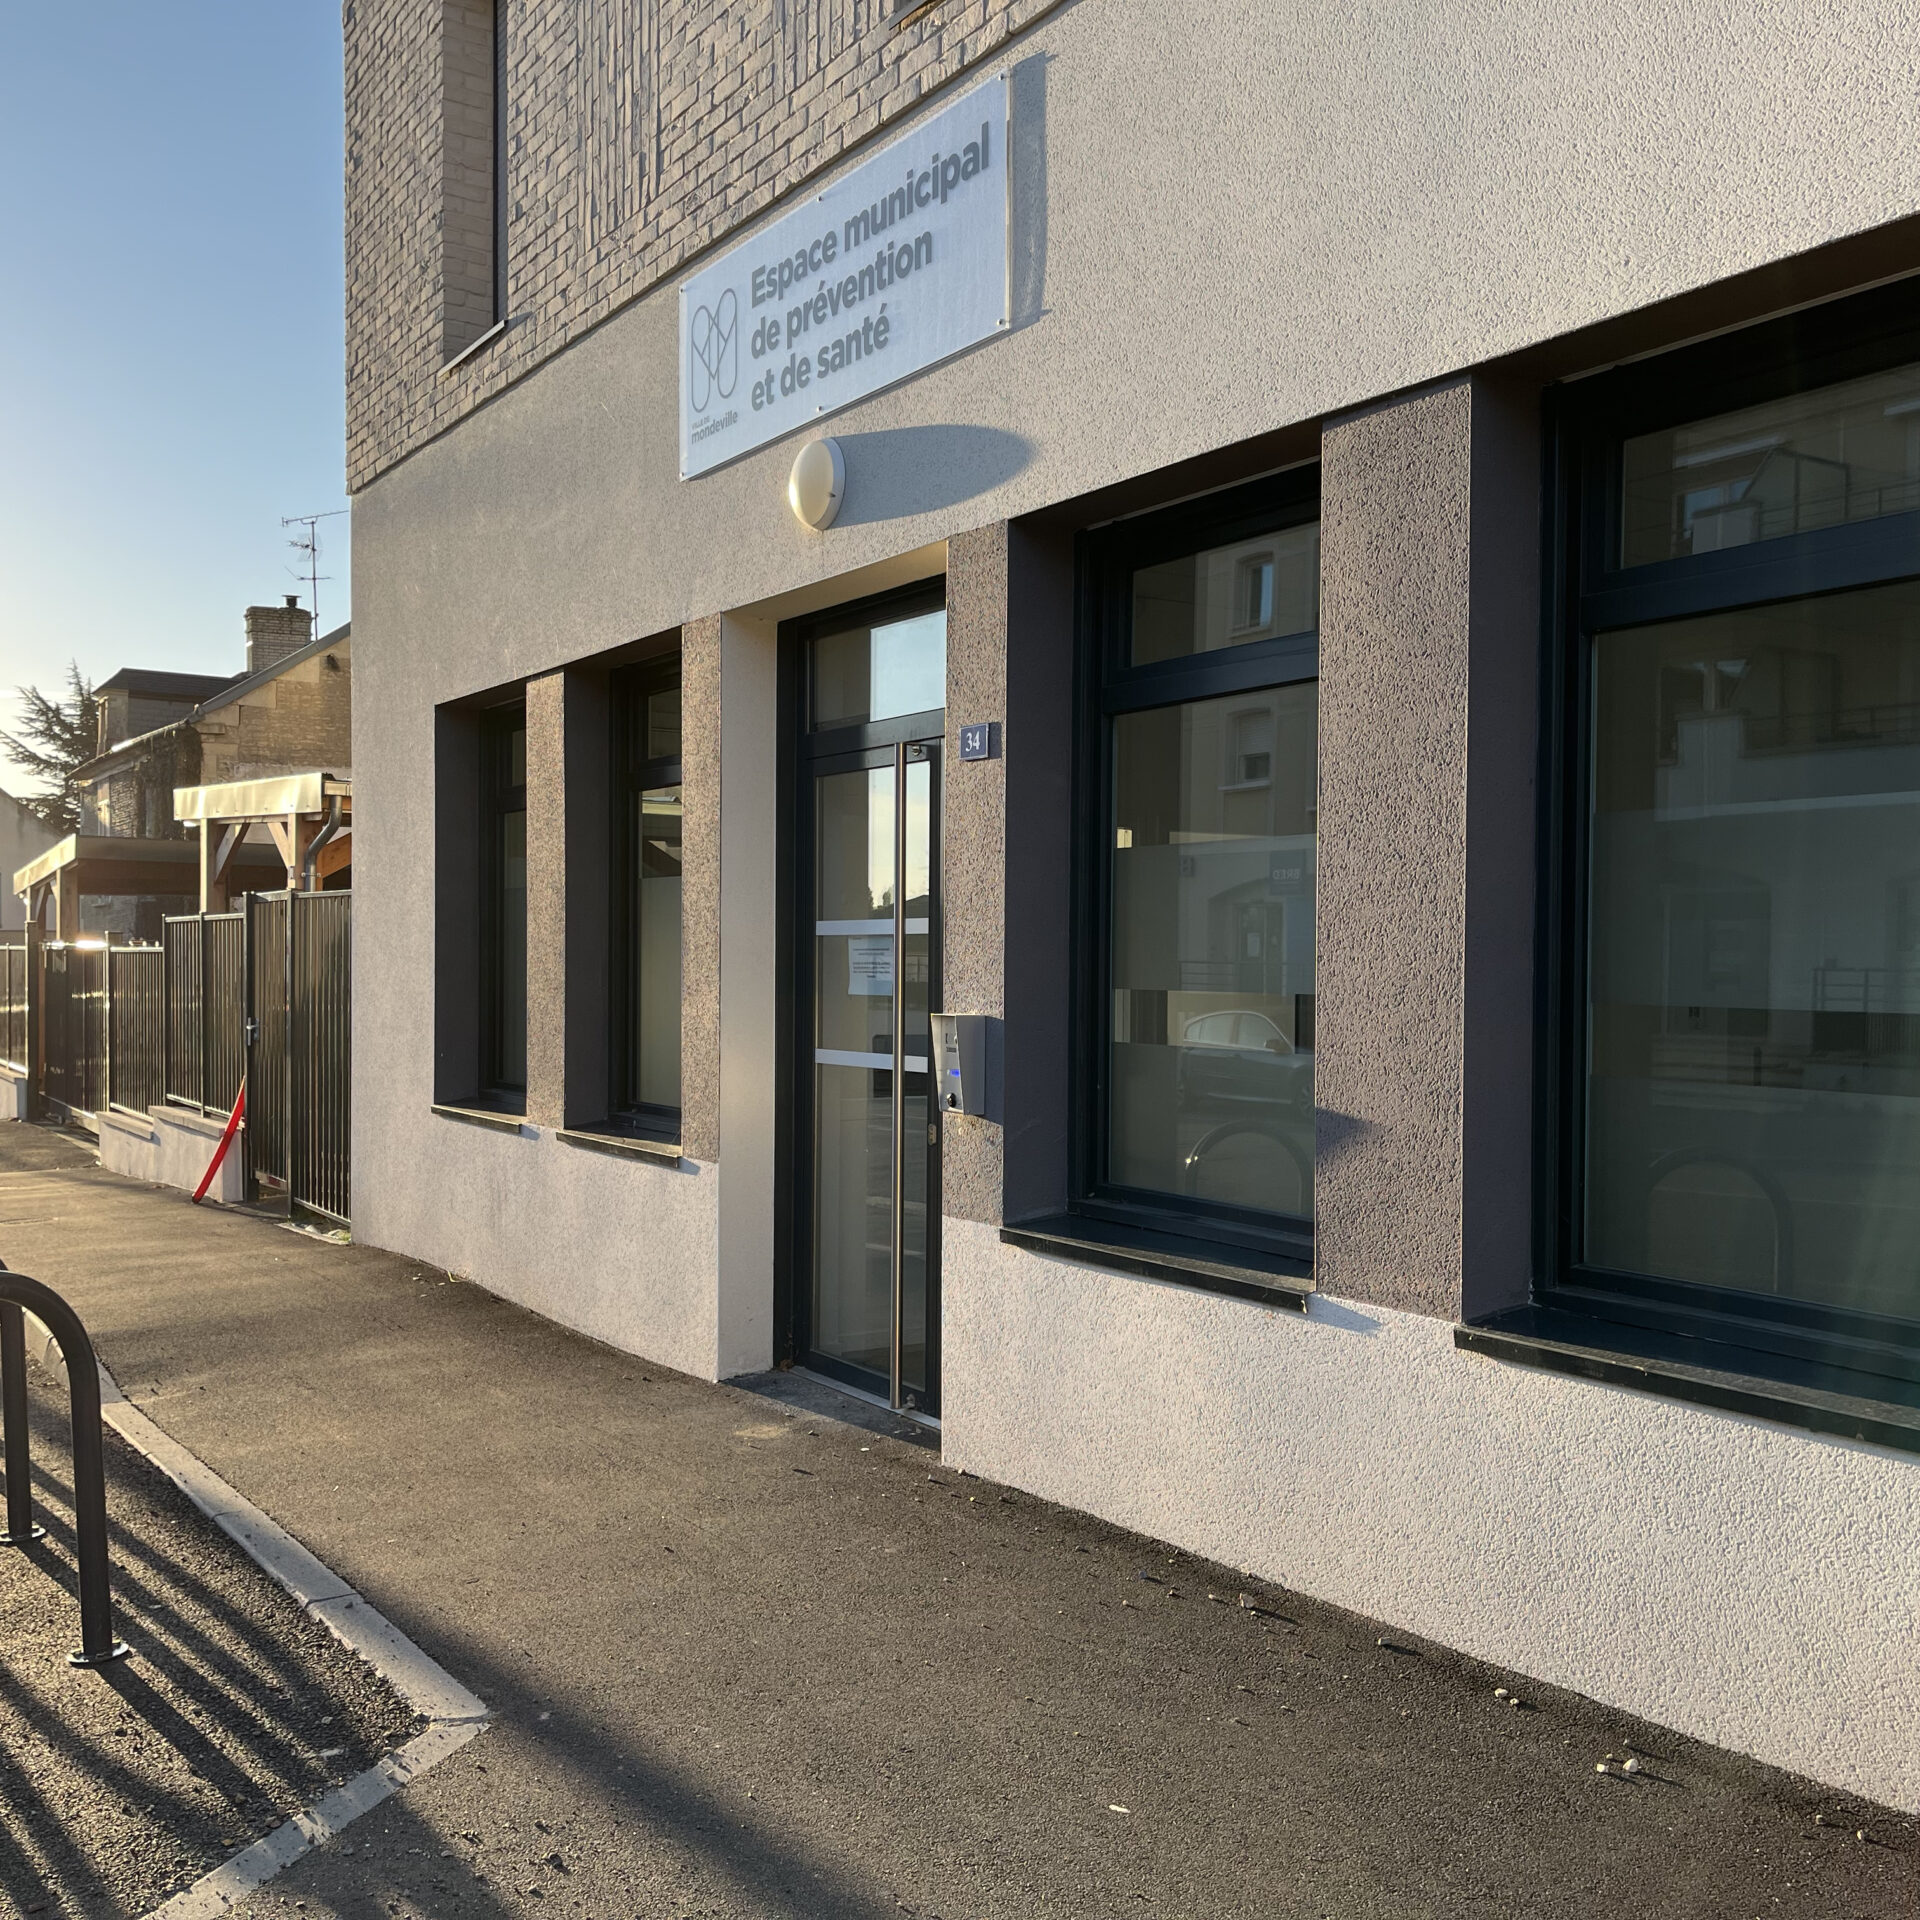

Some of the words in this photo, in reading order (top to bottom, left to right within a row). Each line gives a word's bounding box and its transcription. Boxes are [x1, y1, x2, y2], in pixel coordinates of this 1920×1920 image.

[751, 230, 837, 309] Espace
[844, 121, 990, 252] municipal
[751, 317, 780, 359] de
[786, 230, 933, 349] prévention
[751, 372, 775, 411] et
[780, 351, 810, 398] de
[817, 303, 890, 379] santé
[691, 410, 738, 445] mondeville
[965, 731, 981, 752] 34
